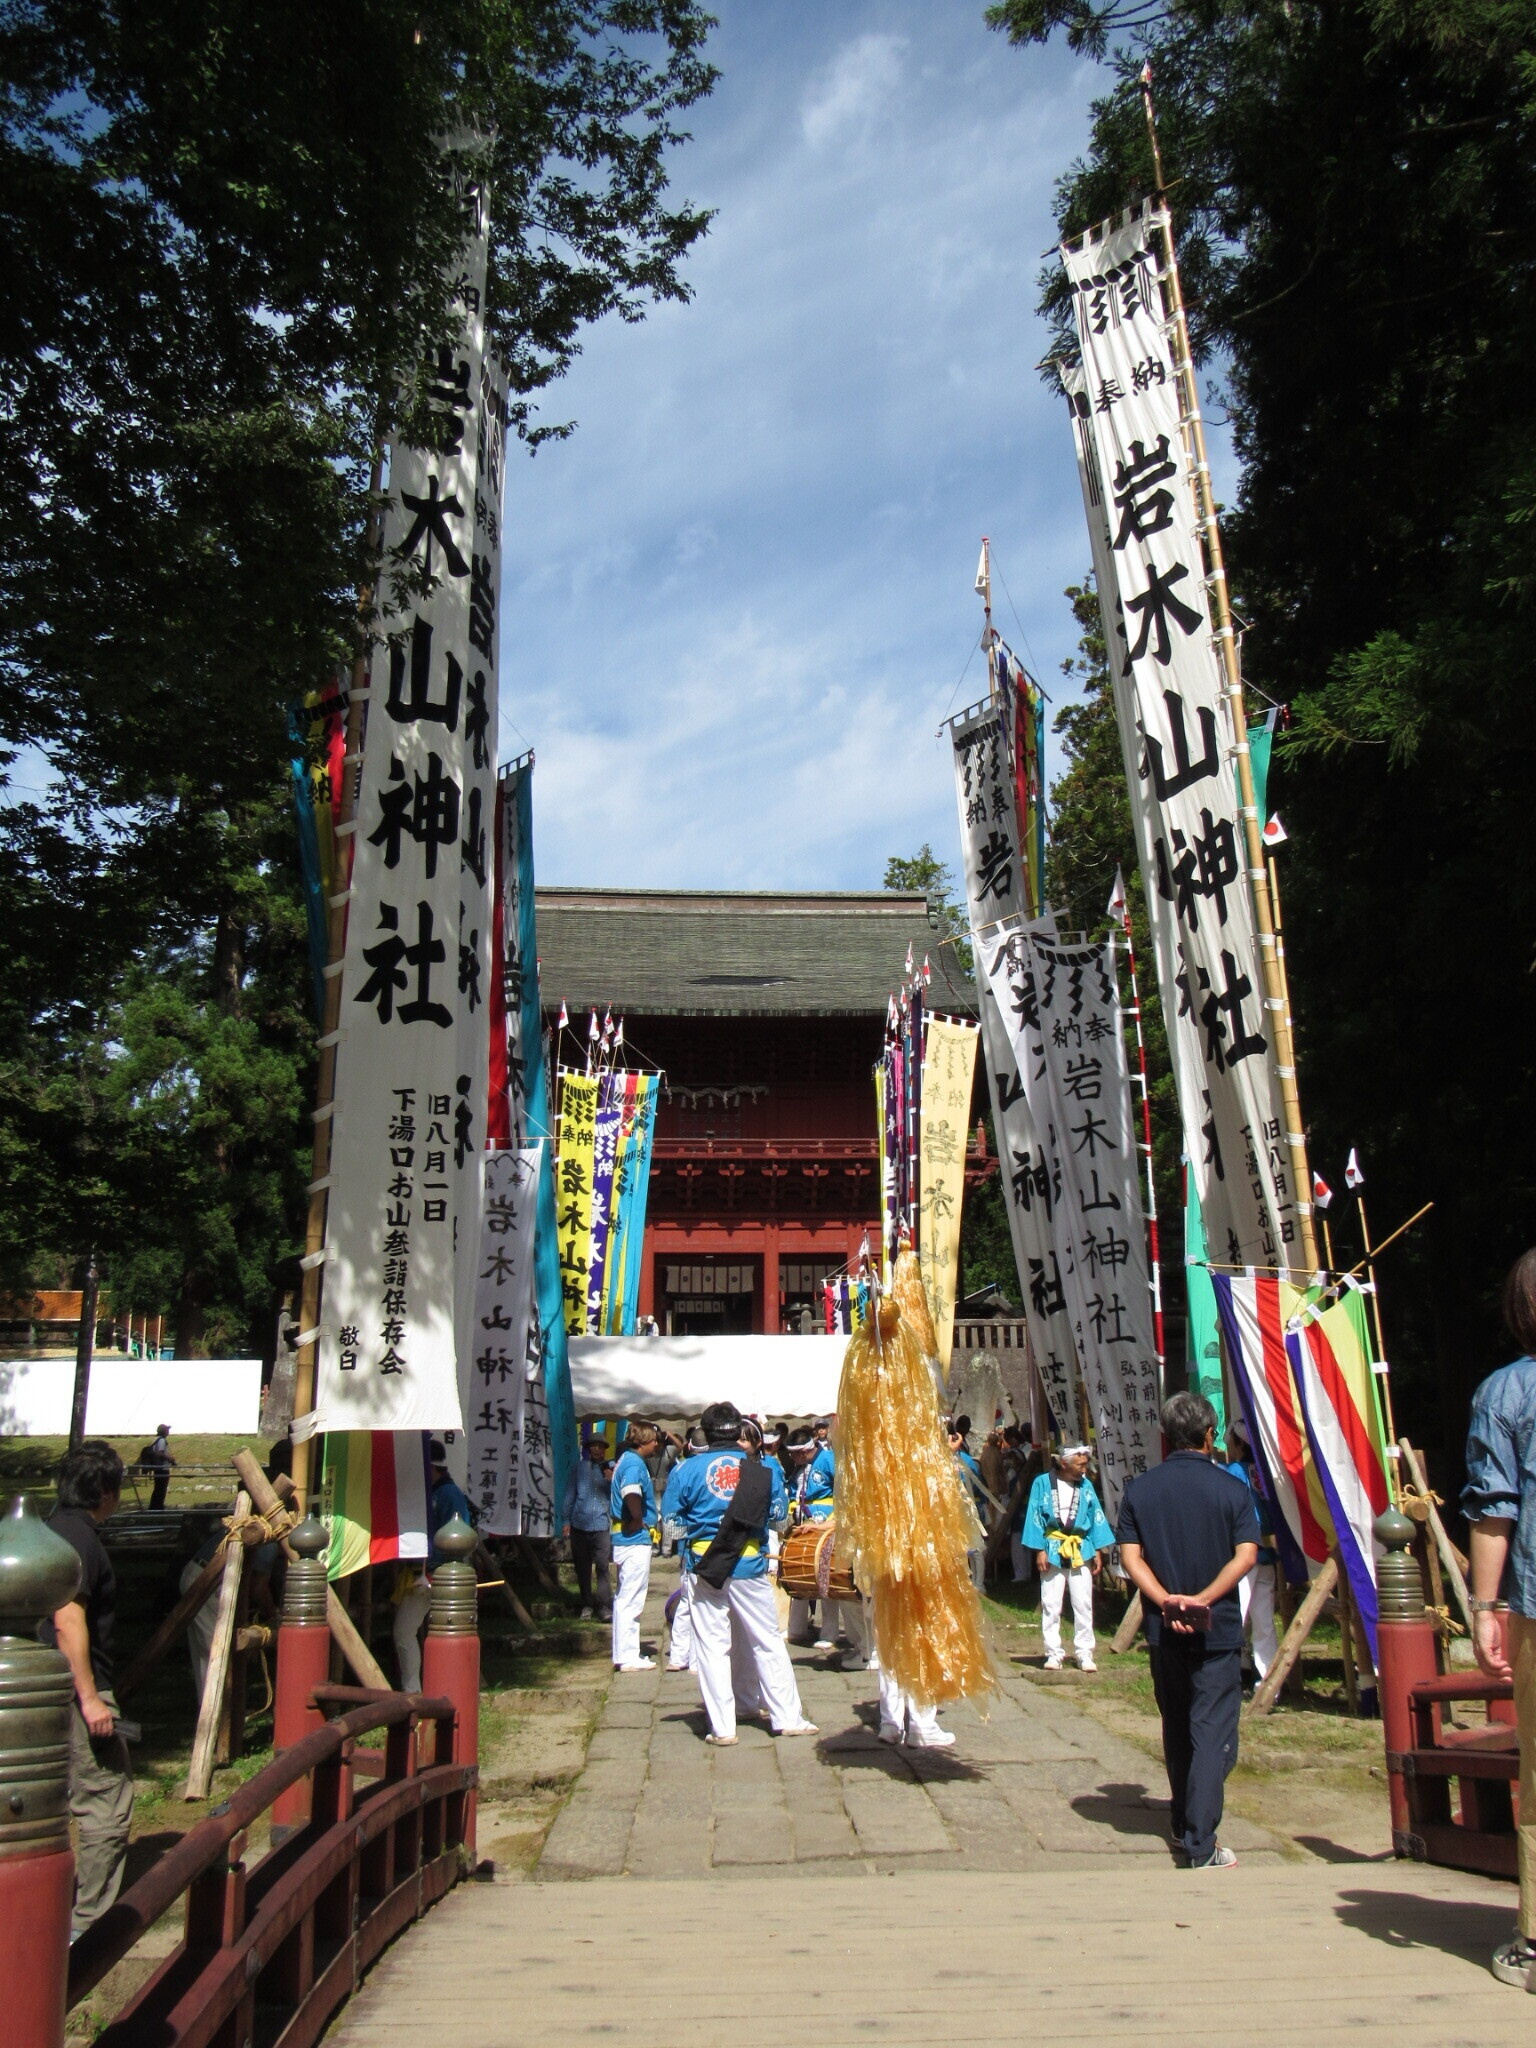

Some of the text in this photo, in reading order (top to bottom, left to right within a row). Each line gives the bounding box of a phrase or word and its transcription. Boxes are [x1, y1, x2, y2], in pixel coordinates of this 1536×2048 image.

[1094, 356, 1166, 414] 奉納
[1112, 434, 1268, 1074] 岩木山神社
[966, 785, 1010, 828] 奉納
[1051, 1012, 1116, 1049] 奉納
[423, 1093, 451, 1223] 旧八月一日
[1263, 1117, 1294, 1244] 旧八月一日
[1062, 1052, 1137, 1346] 岩木山神社
[338, 1326, 360, 1371] 敬白
[1140, 1360, 1158, 1426] 弘前市
